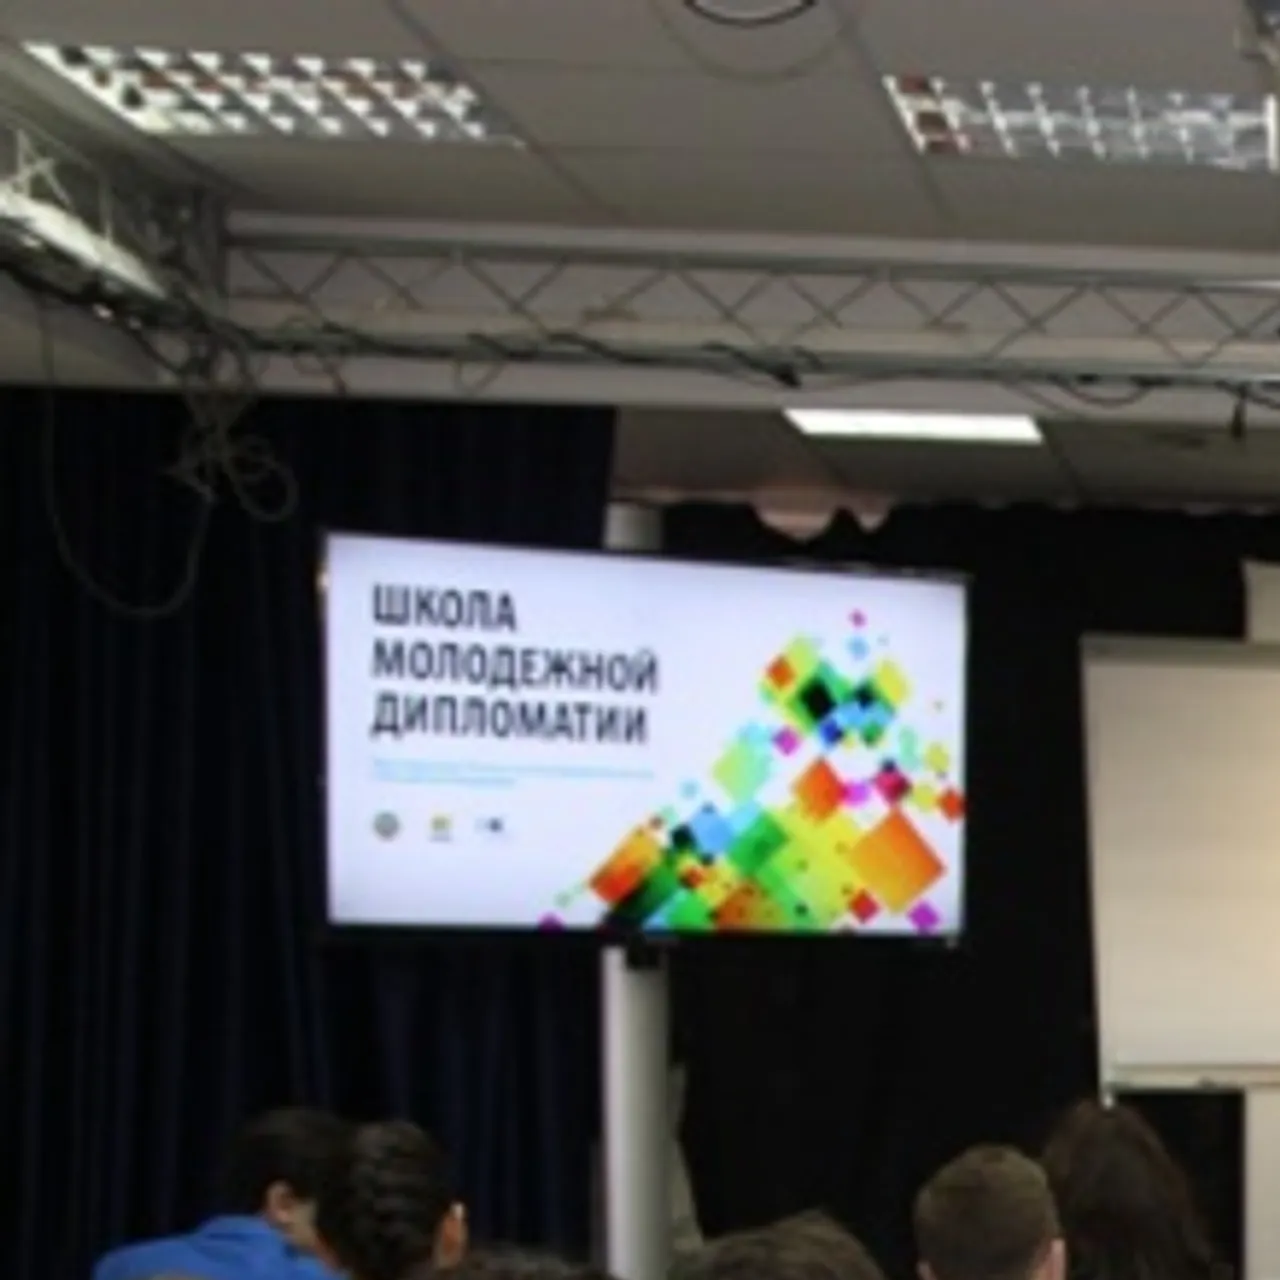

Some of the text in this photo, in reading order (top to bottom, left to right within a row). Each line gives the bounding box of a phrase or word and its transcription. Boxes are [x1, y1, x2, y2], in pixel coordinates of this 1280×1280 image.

[371, 584, 517, 630] ШКОЛА
[371, 638, 659, 692] МОЛОДЕЖНОЙ
[369, 692, 650, 745] ДИПЛОМАТИИ
